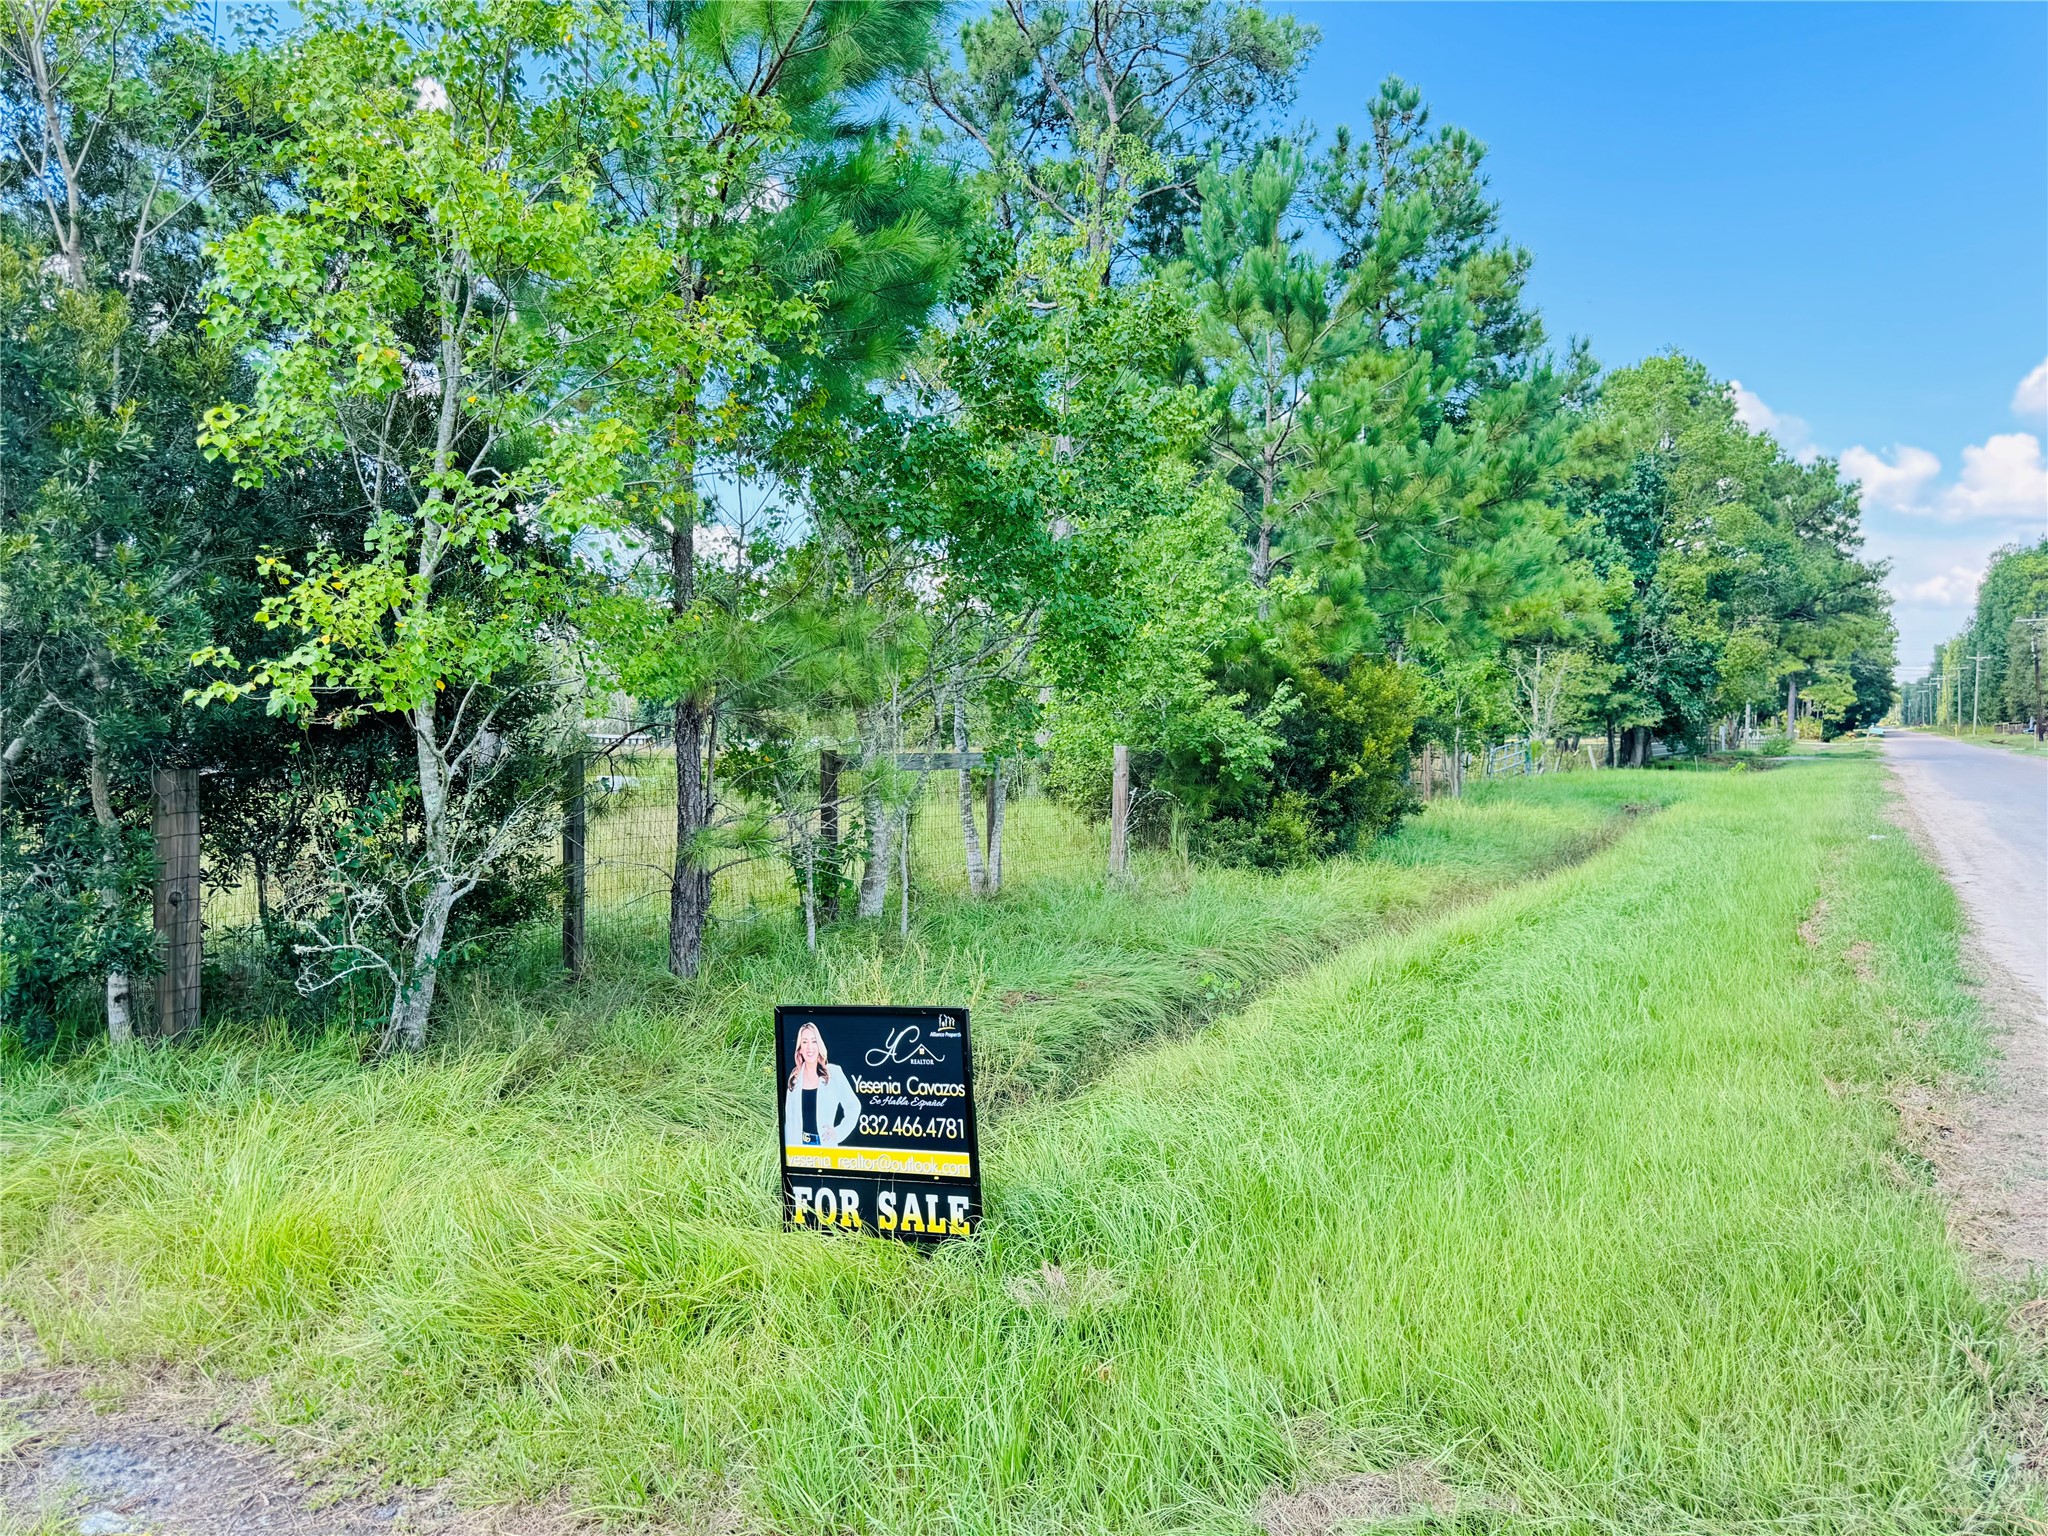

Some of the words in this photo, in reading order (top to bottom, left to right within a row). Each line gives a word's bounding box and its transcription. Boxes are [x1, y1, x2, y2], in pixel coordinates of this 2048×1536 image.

[910, 1058, 935, 1066] REALTOR
[851, 1074, 901, 1095] Yesenia
[906, 1076, 966, 1097] Cavazos
[869, 1095, 882, 1105] Se
[882, 1096, 909, 1107] Habla
[910, 1097, 948, 1110] Español
[859, 1114, 965, 1139] 832.466.4781
[792, 1186, 863, 1228] FOR
[878, 1190, 971, 1236] SALE
